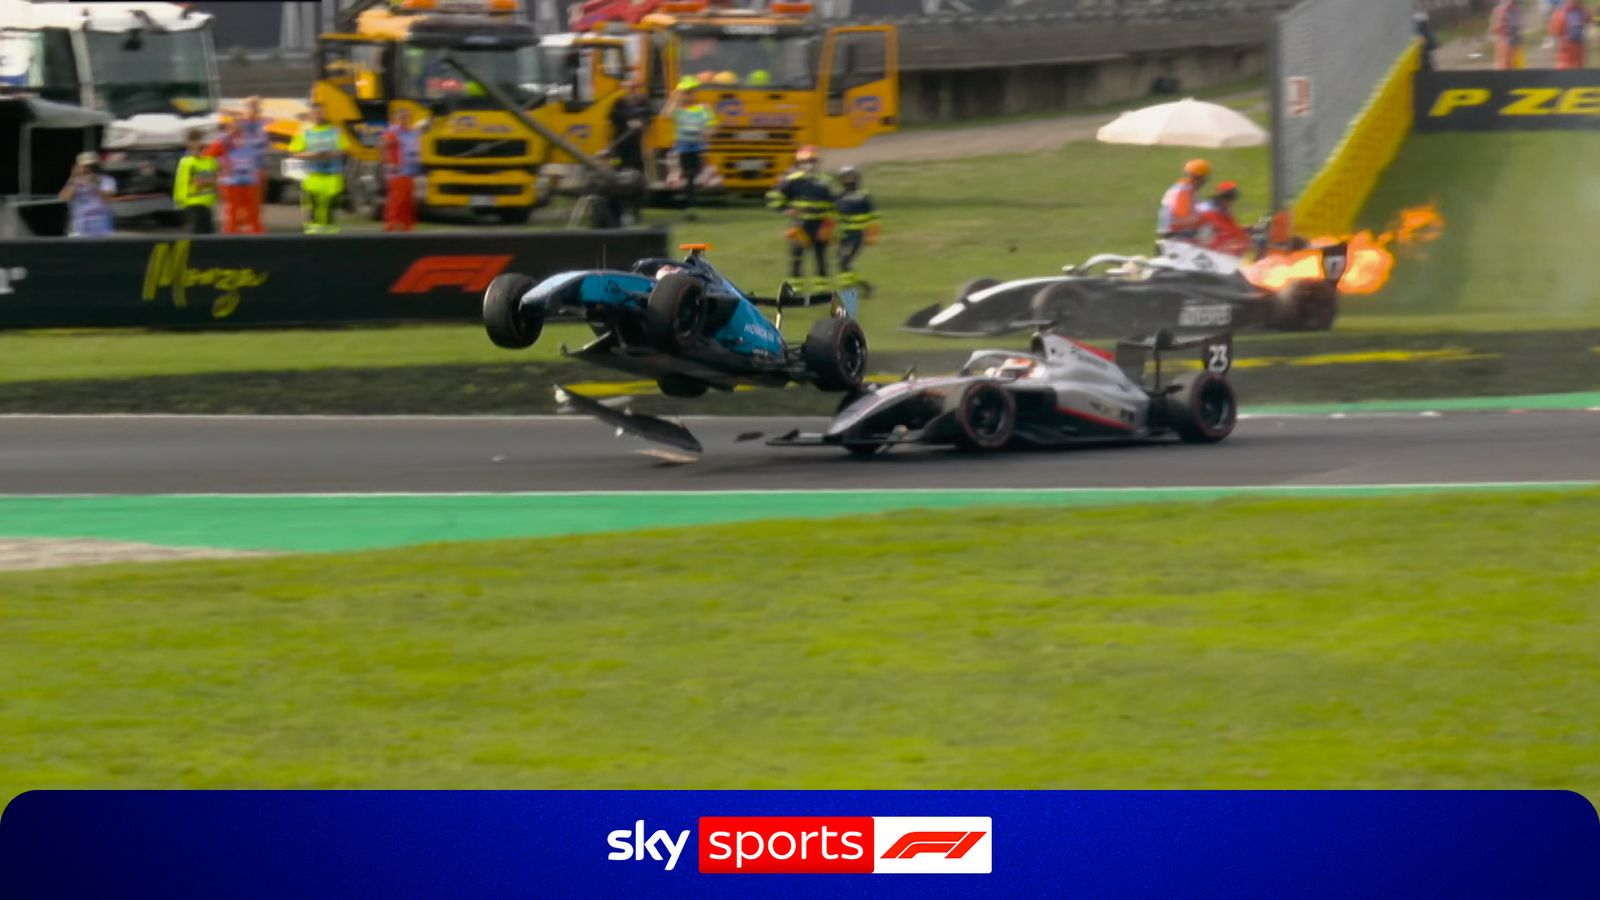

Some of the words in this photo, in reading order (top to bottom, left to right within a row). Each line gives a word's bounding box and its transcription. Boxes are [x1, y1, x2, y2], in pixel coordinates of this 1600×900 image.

[1428, 88, 1491, 117] P
[1498, 87, 1600, 115] ZE
[1208, 343, 1229, 373] 23
